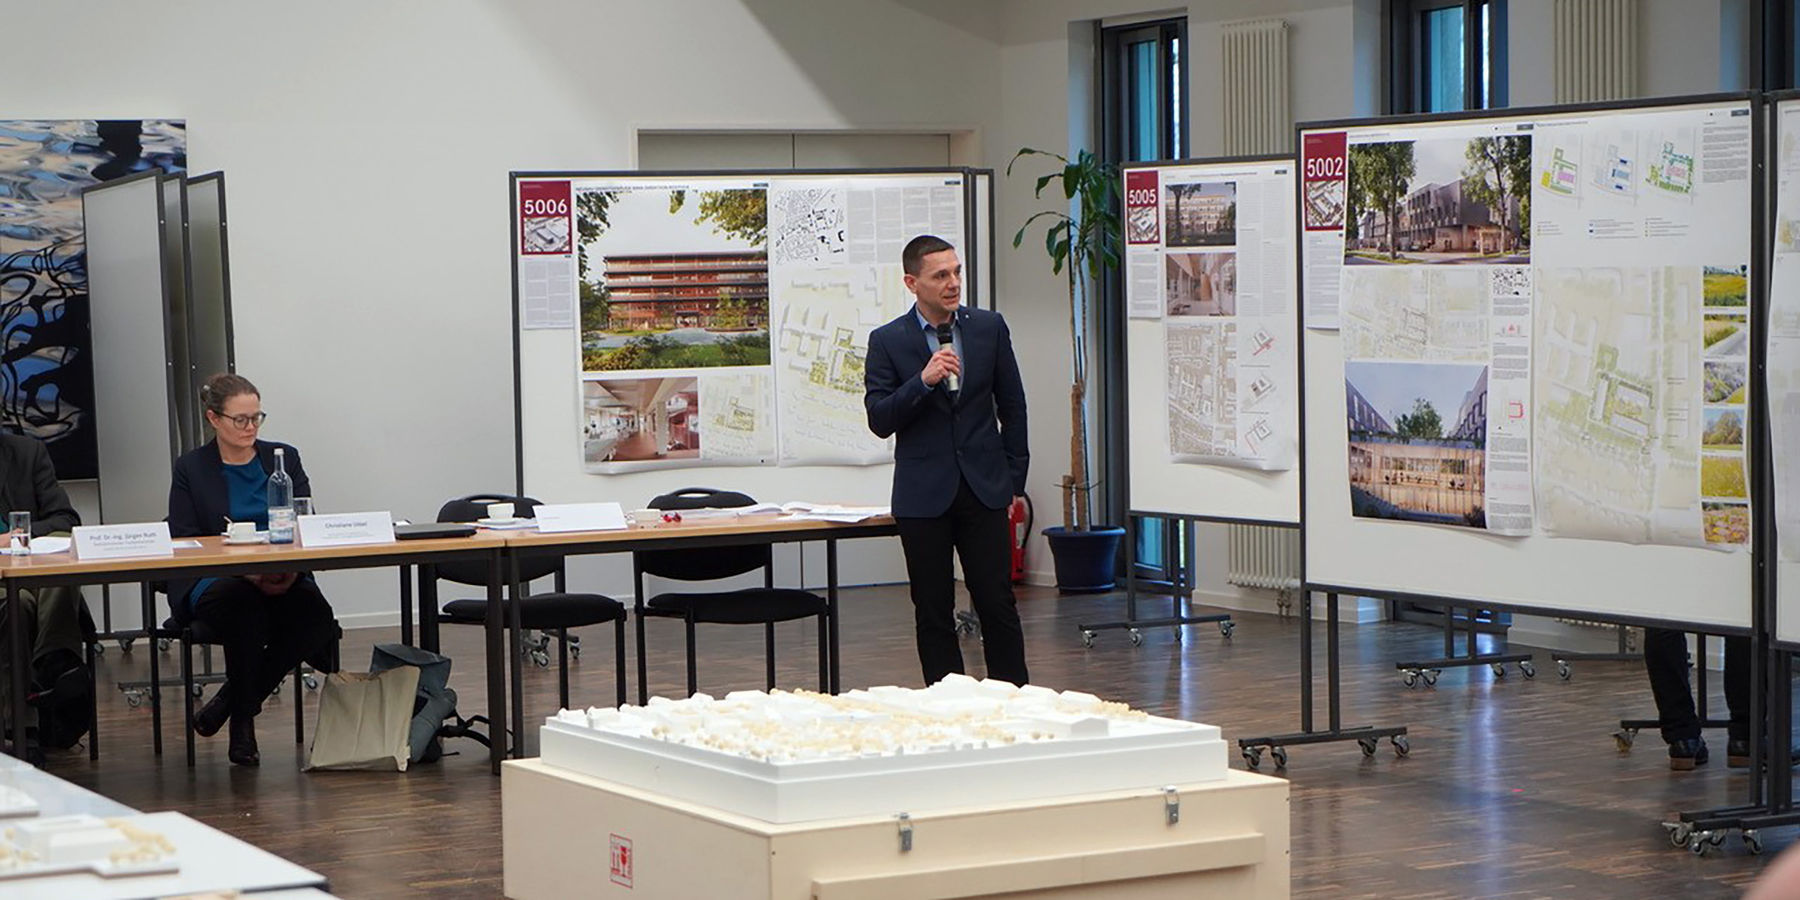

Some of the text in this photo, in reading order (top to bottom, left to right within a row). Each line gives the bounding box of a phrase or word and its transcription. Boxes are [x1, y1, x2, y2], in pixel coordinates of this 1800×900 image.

[1307, 156, 1343, 178] 5002
[1128, 188, 1157, 205] 5005
[524, 199, 568, 215] 5006
